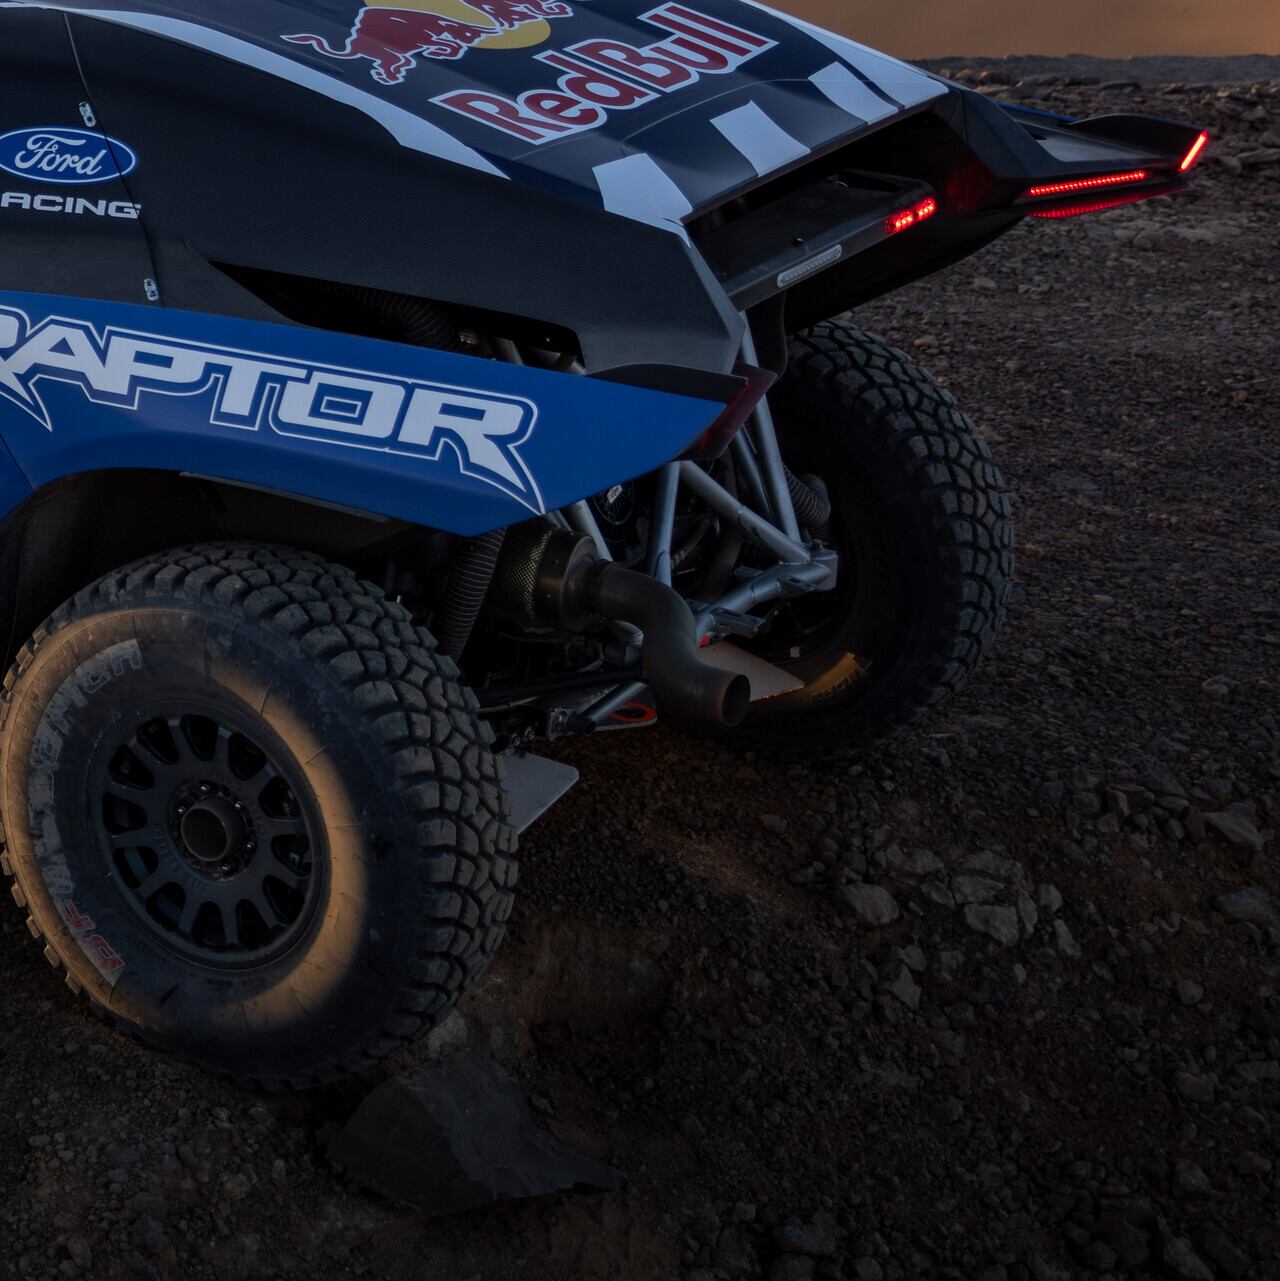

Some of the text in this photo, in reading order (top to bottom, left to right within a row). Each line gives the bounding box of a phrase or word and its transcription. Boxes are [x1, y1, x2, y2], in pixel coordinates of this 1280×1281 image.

[427, 1, 779, 145] Red Bull
[14, 133, 108, 176] Ford
